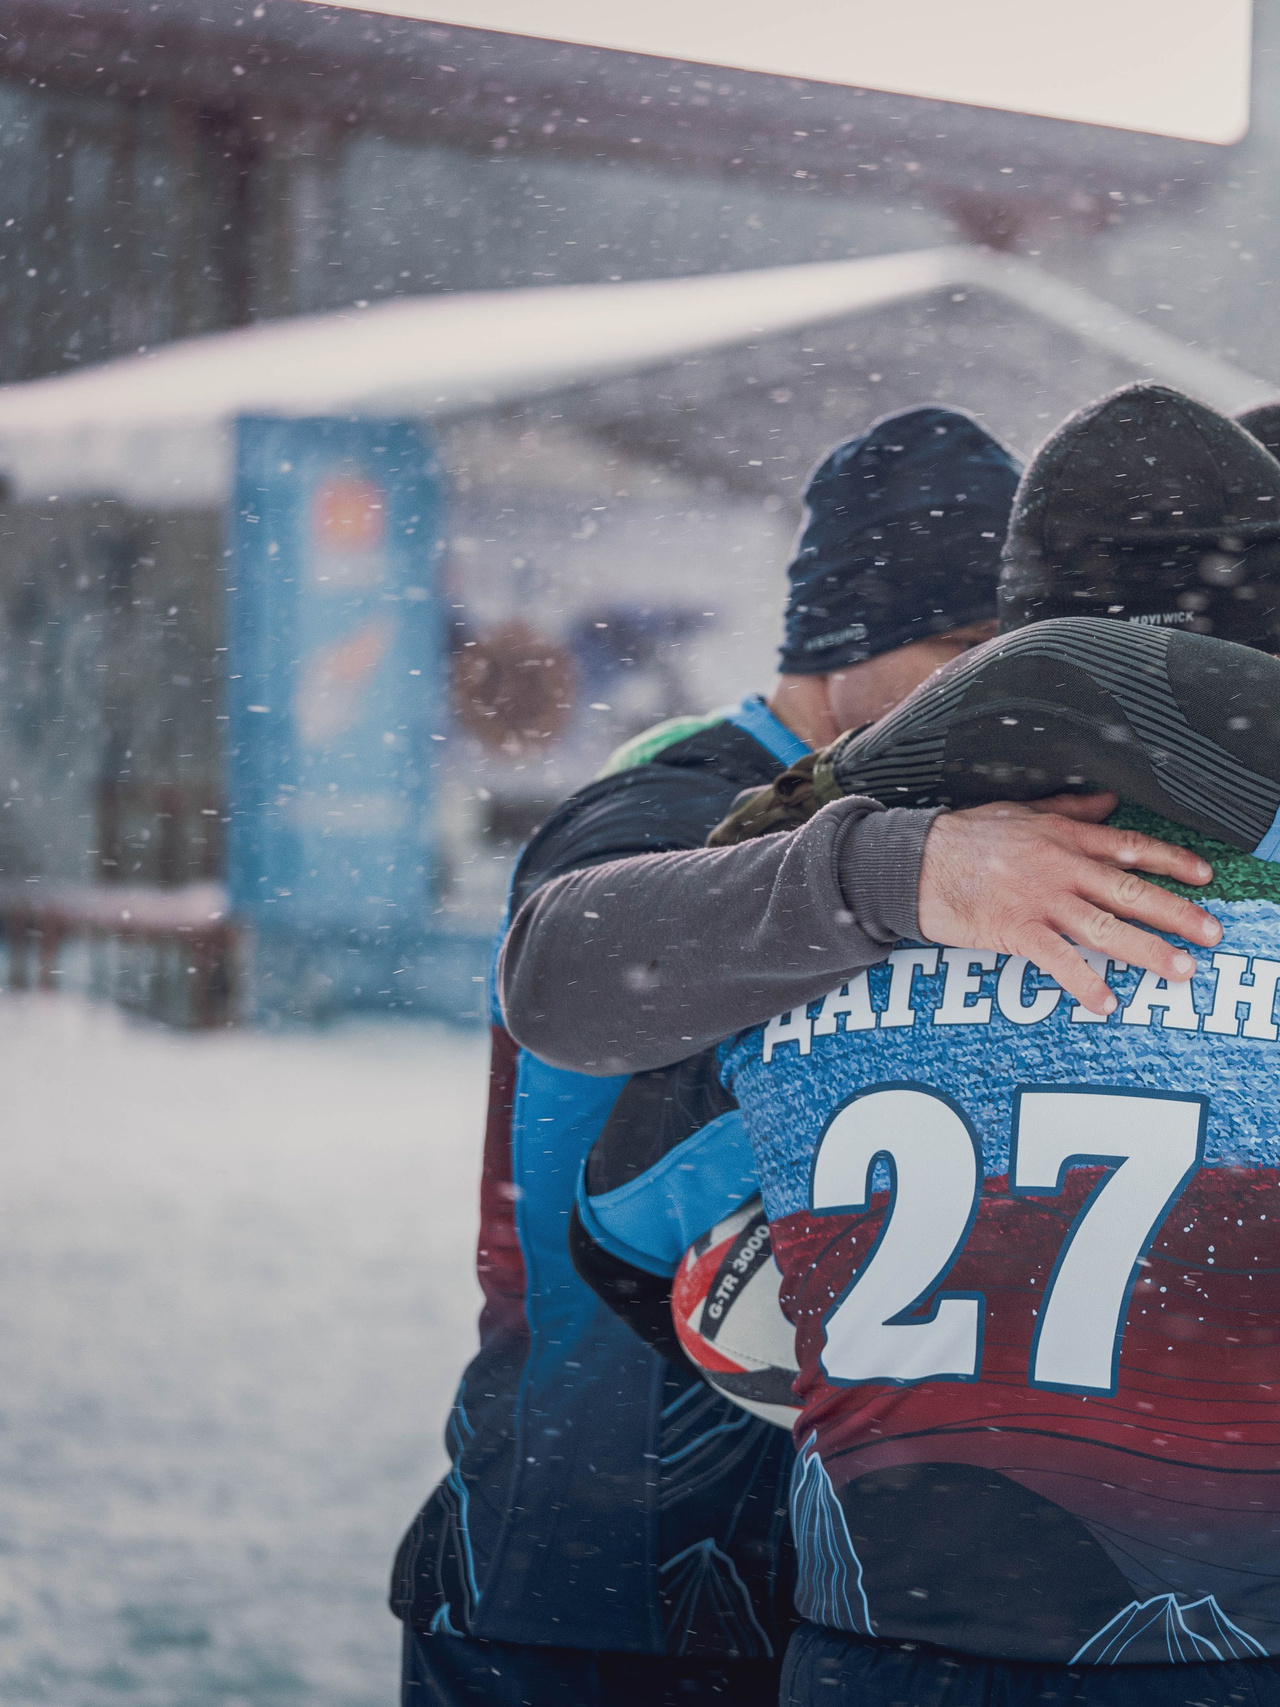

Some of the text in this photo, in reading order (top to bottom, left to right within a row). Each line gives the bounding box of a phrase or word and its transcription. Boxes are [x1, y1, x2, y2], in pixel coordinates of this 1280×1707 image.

[709, 1224, 770, 1319] G-TR 3000
[810, 1081, 1207, 1396] 27
